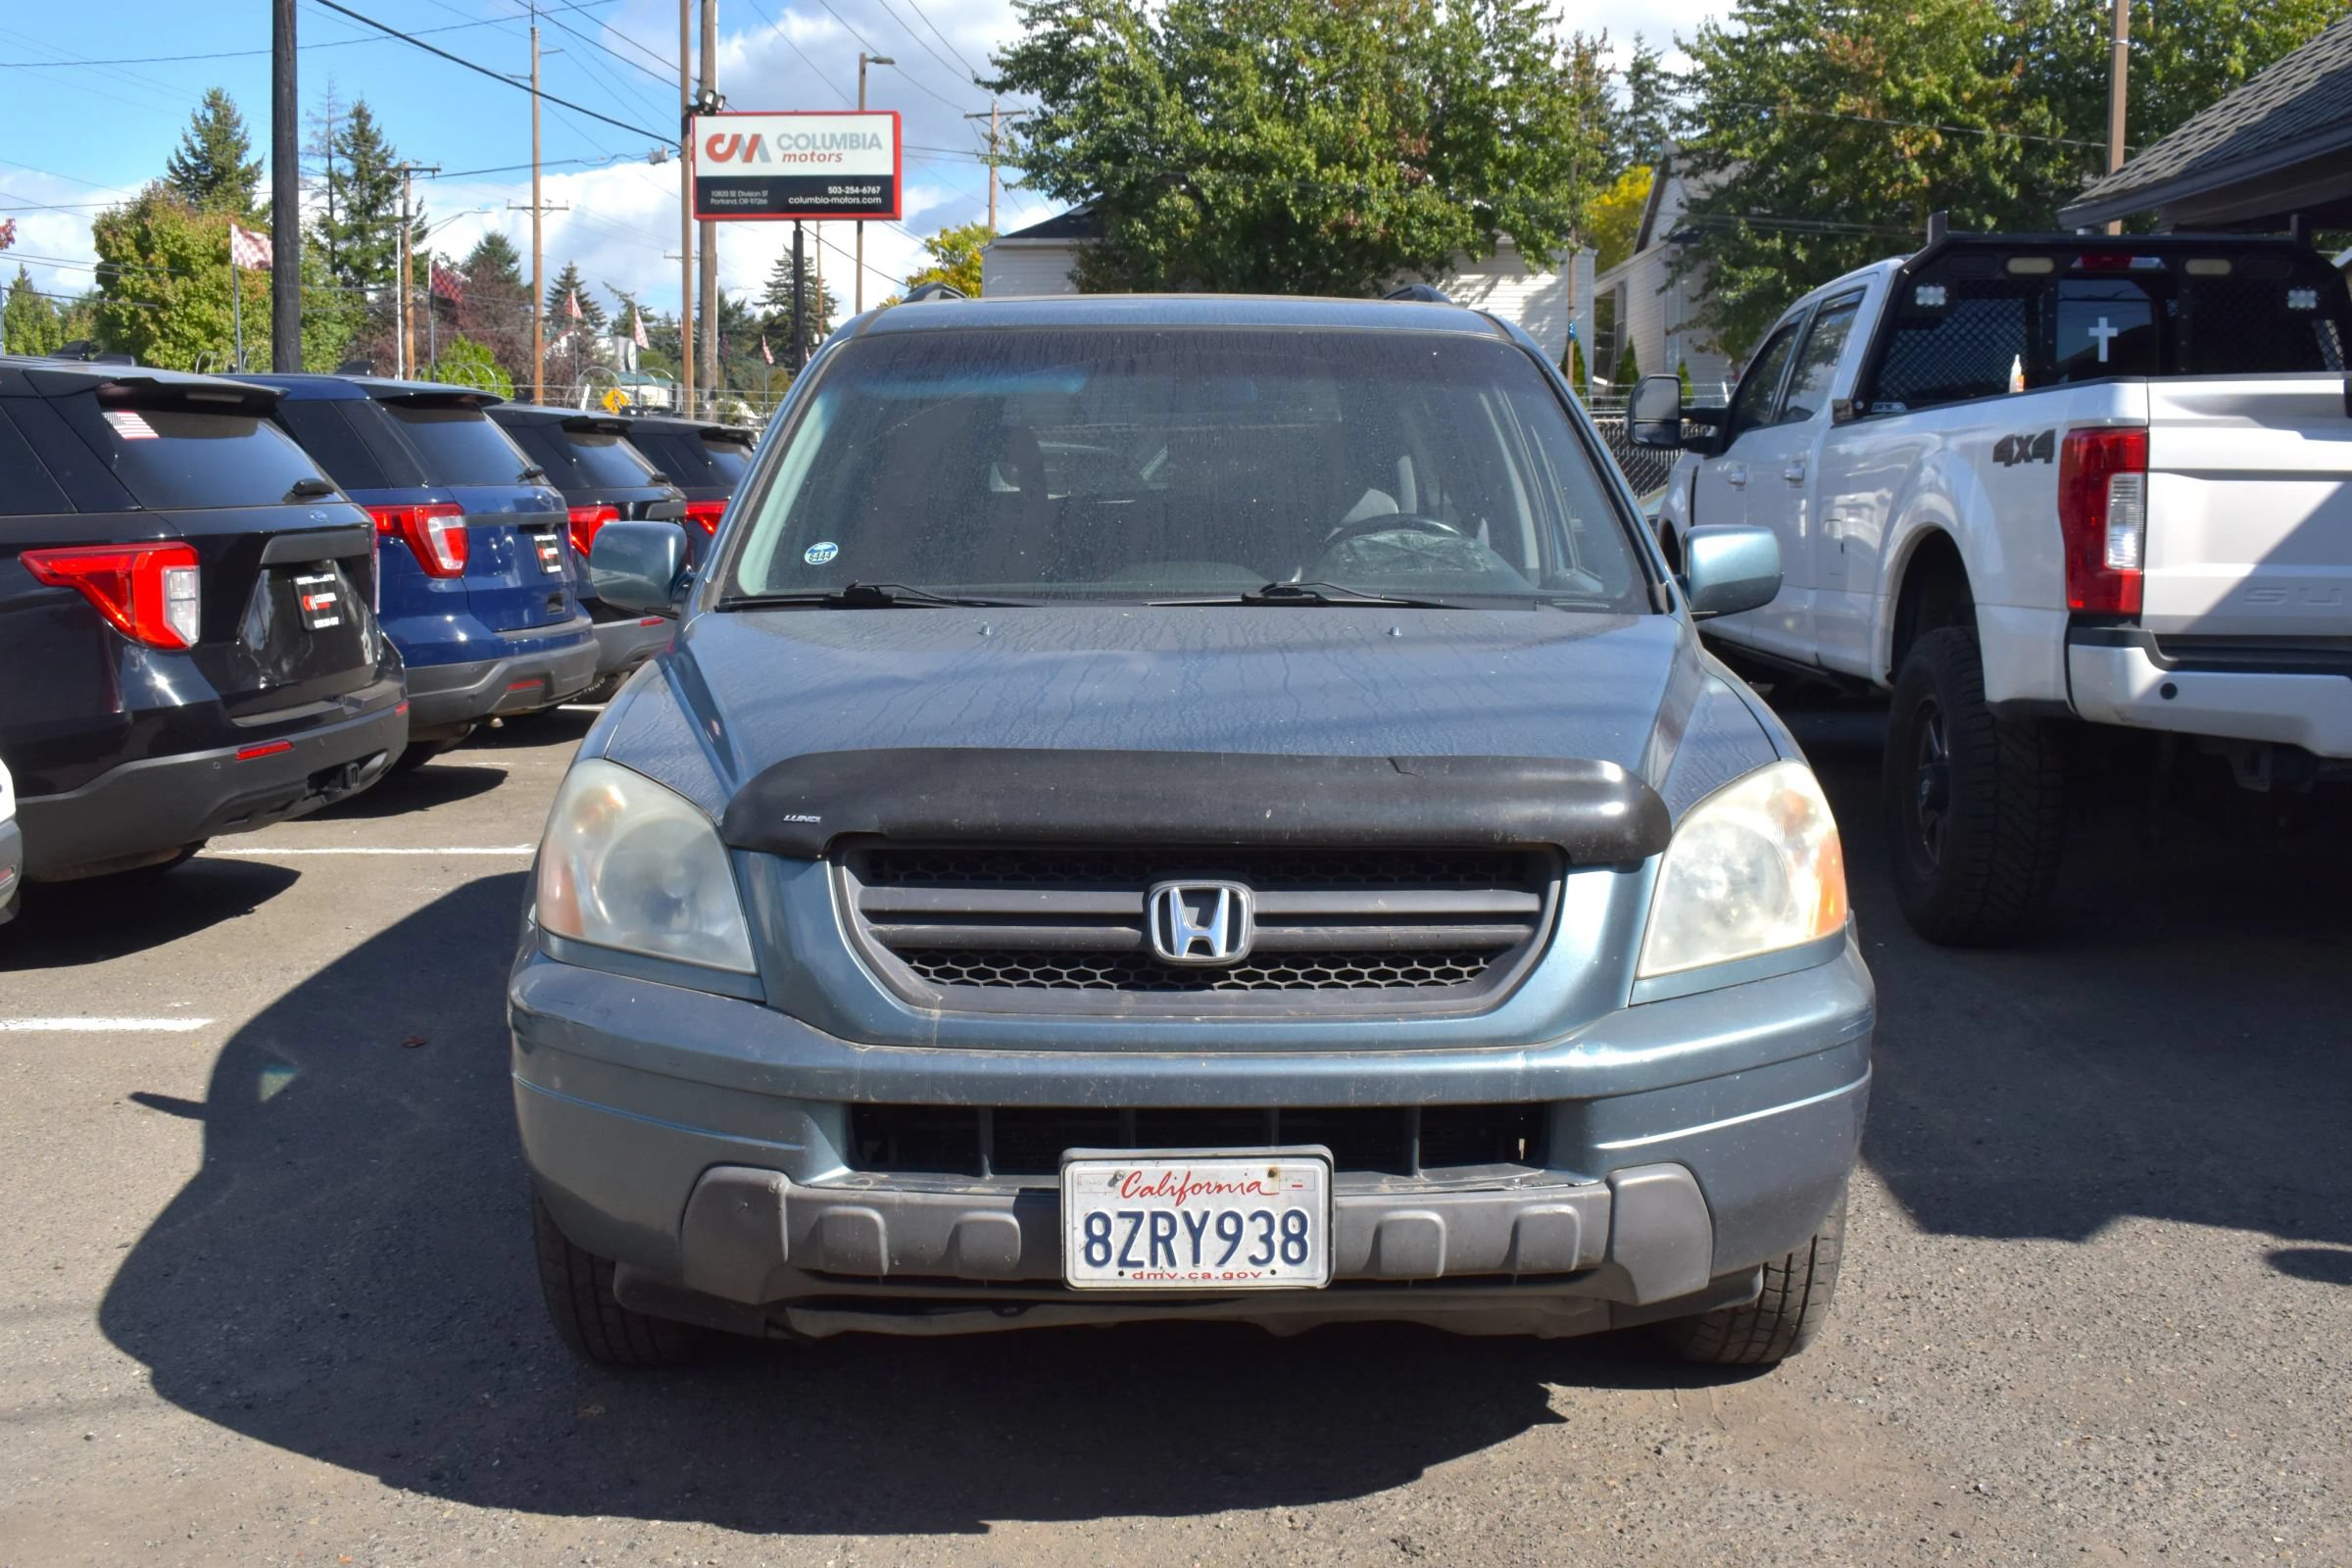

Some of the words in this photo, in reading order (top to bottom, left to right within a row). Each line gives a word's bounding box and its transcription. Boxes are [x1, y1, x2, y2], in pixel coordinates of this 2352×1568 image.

[776, 132, 883, 150] COLUMBIA
[782, 151, 843, 163] motors
[788, 196, 882, 205] columbia-motors.com
[1120, 1170, 1279, 1206] California
[1084, 1209, 1309, 1268] 8ZRY938
[1132, 1270, 1263, 1281] dmv.ca.gov
